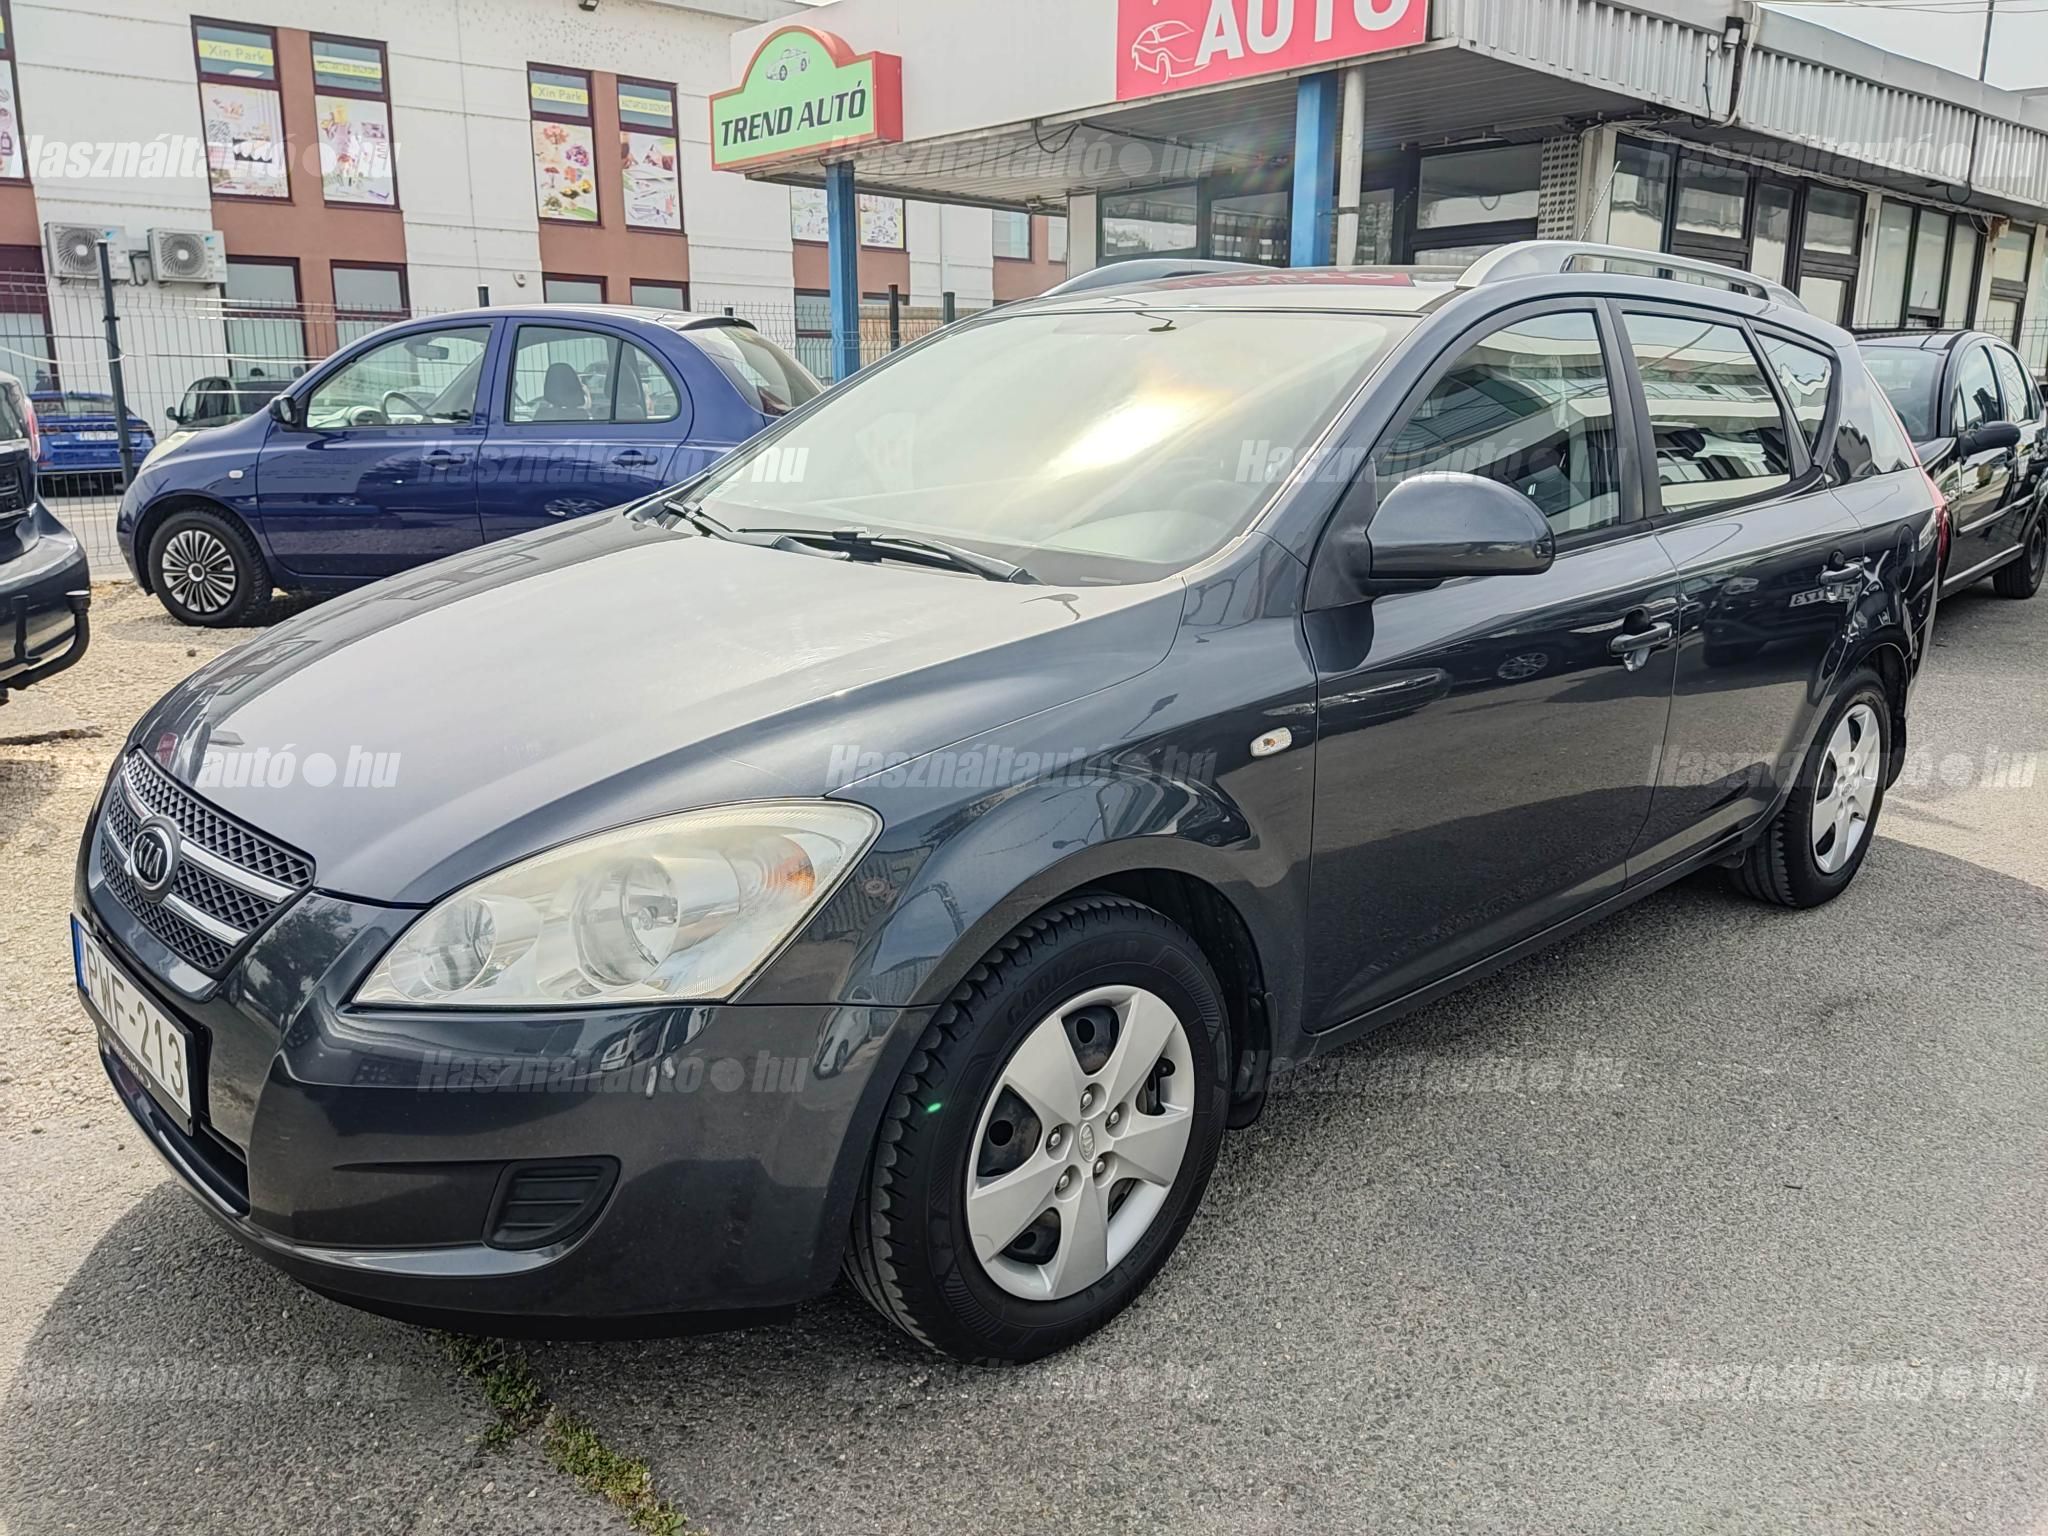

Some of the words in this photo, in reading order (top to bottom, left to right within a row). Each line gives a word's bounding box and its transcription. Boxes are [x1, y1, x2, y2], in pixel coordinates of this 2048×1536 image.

[208, 43, 231, 58] Xin
[236, 48, 265, 63] Park
[538, 86, 556, 98] Xin
[559, 89, 582, 102] Park
[721, 106, 793, 146] TREND
[797, 80, 866, 131] AUTÓ
[134, 836, 163, 881] KIA
[86, 942, 184, 1099] PWF-213
